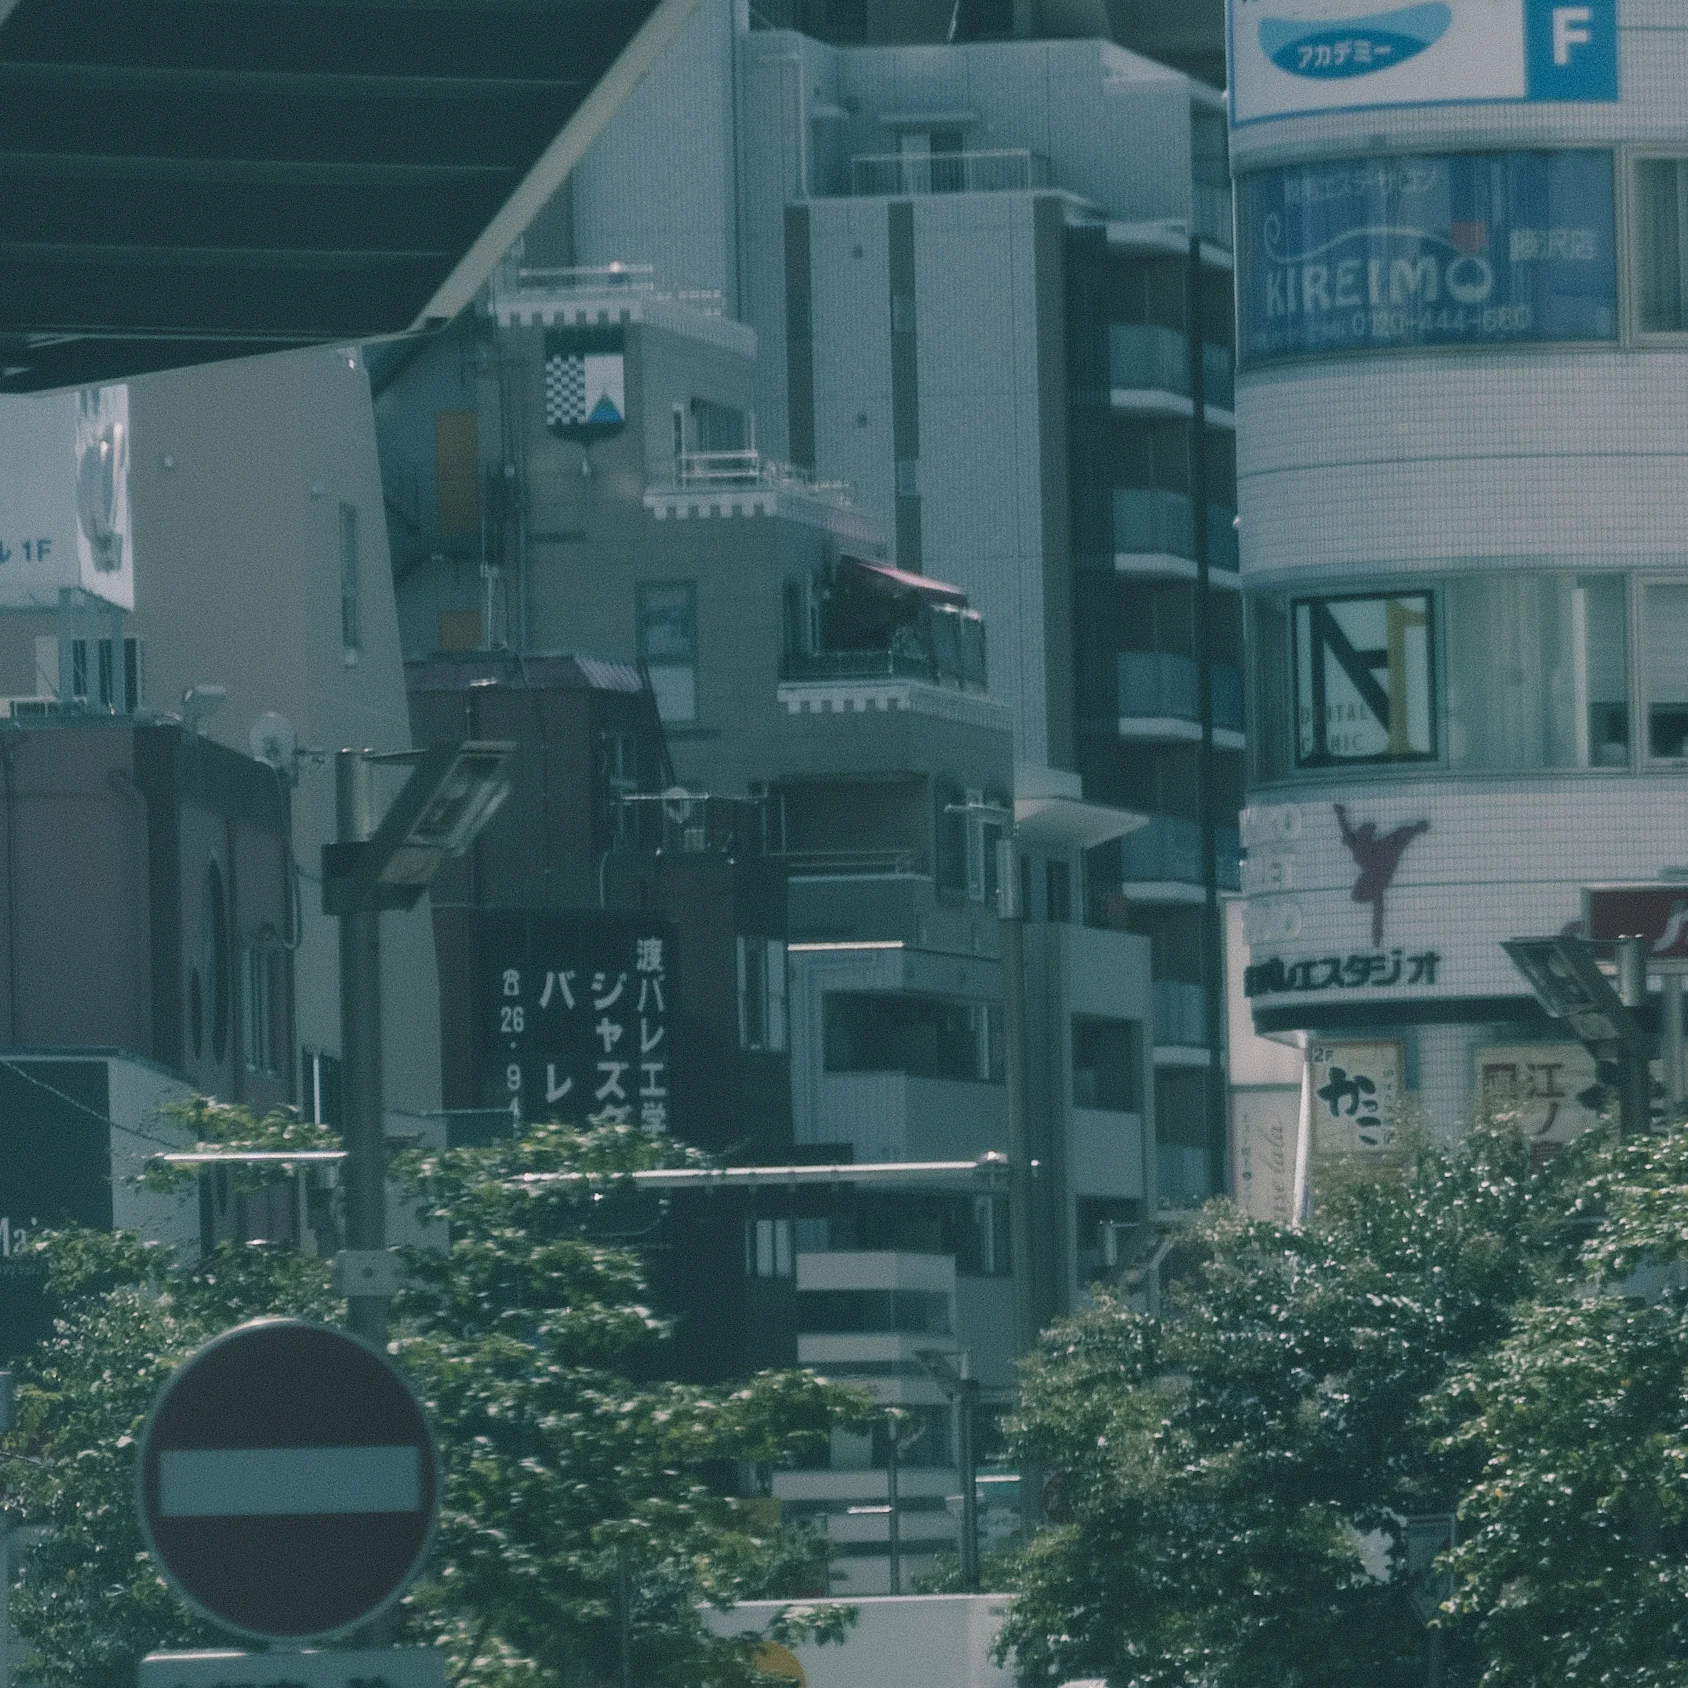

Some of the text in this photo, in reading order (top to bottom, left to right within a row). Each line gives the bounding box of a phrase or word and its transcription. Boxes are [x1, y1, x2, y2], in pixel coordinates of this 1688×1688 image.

[1297, 40, 1395, 70] アカデミー
[1264, 254, 1495, 320] KIREIMO
